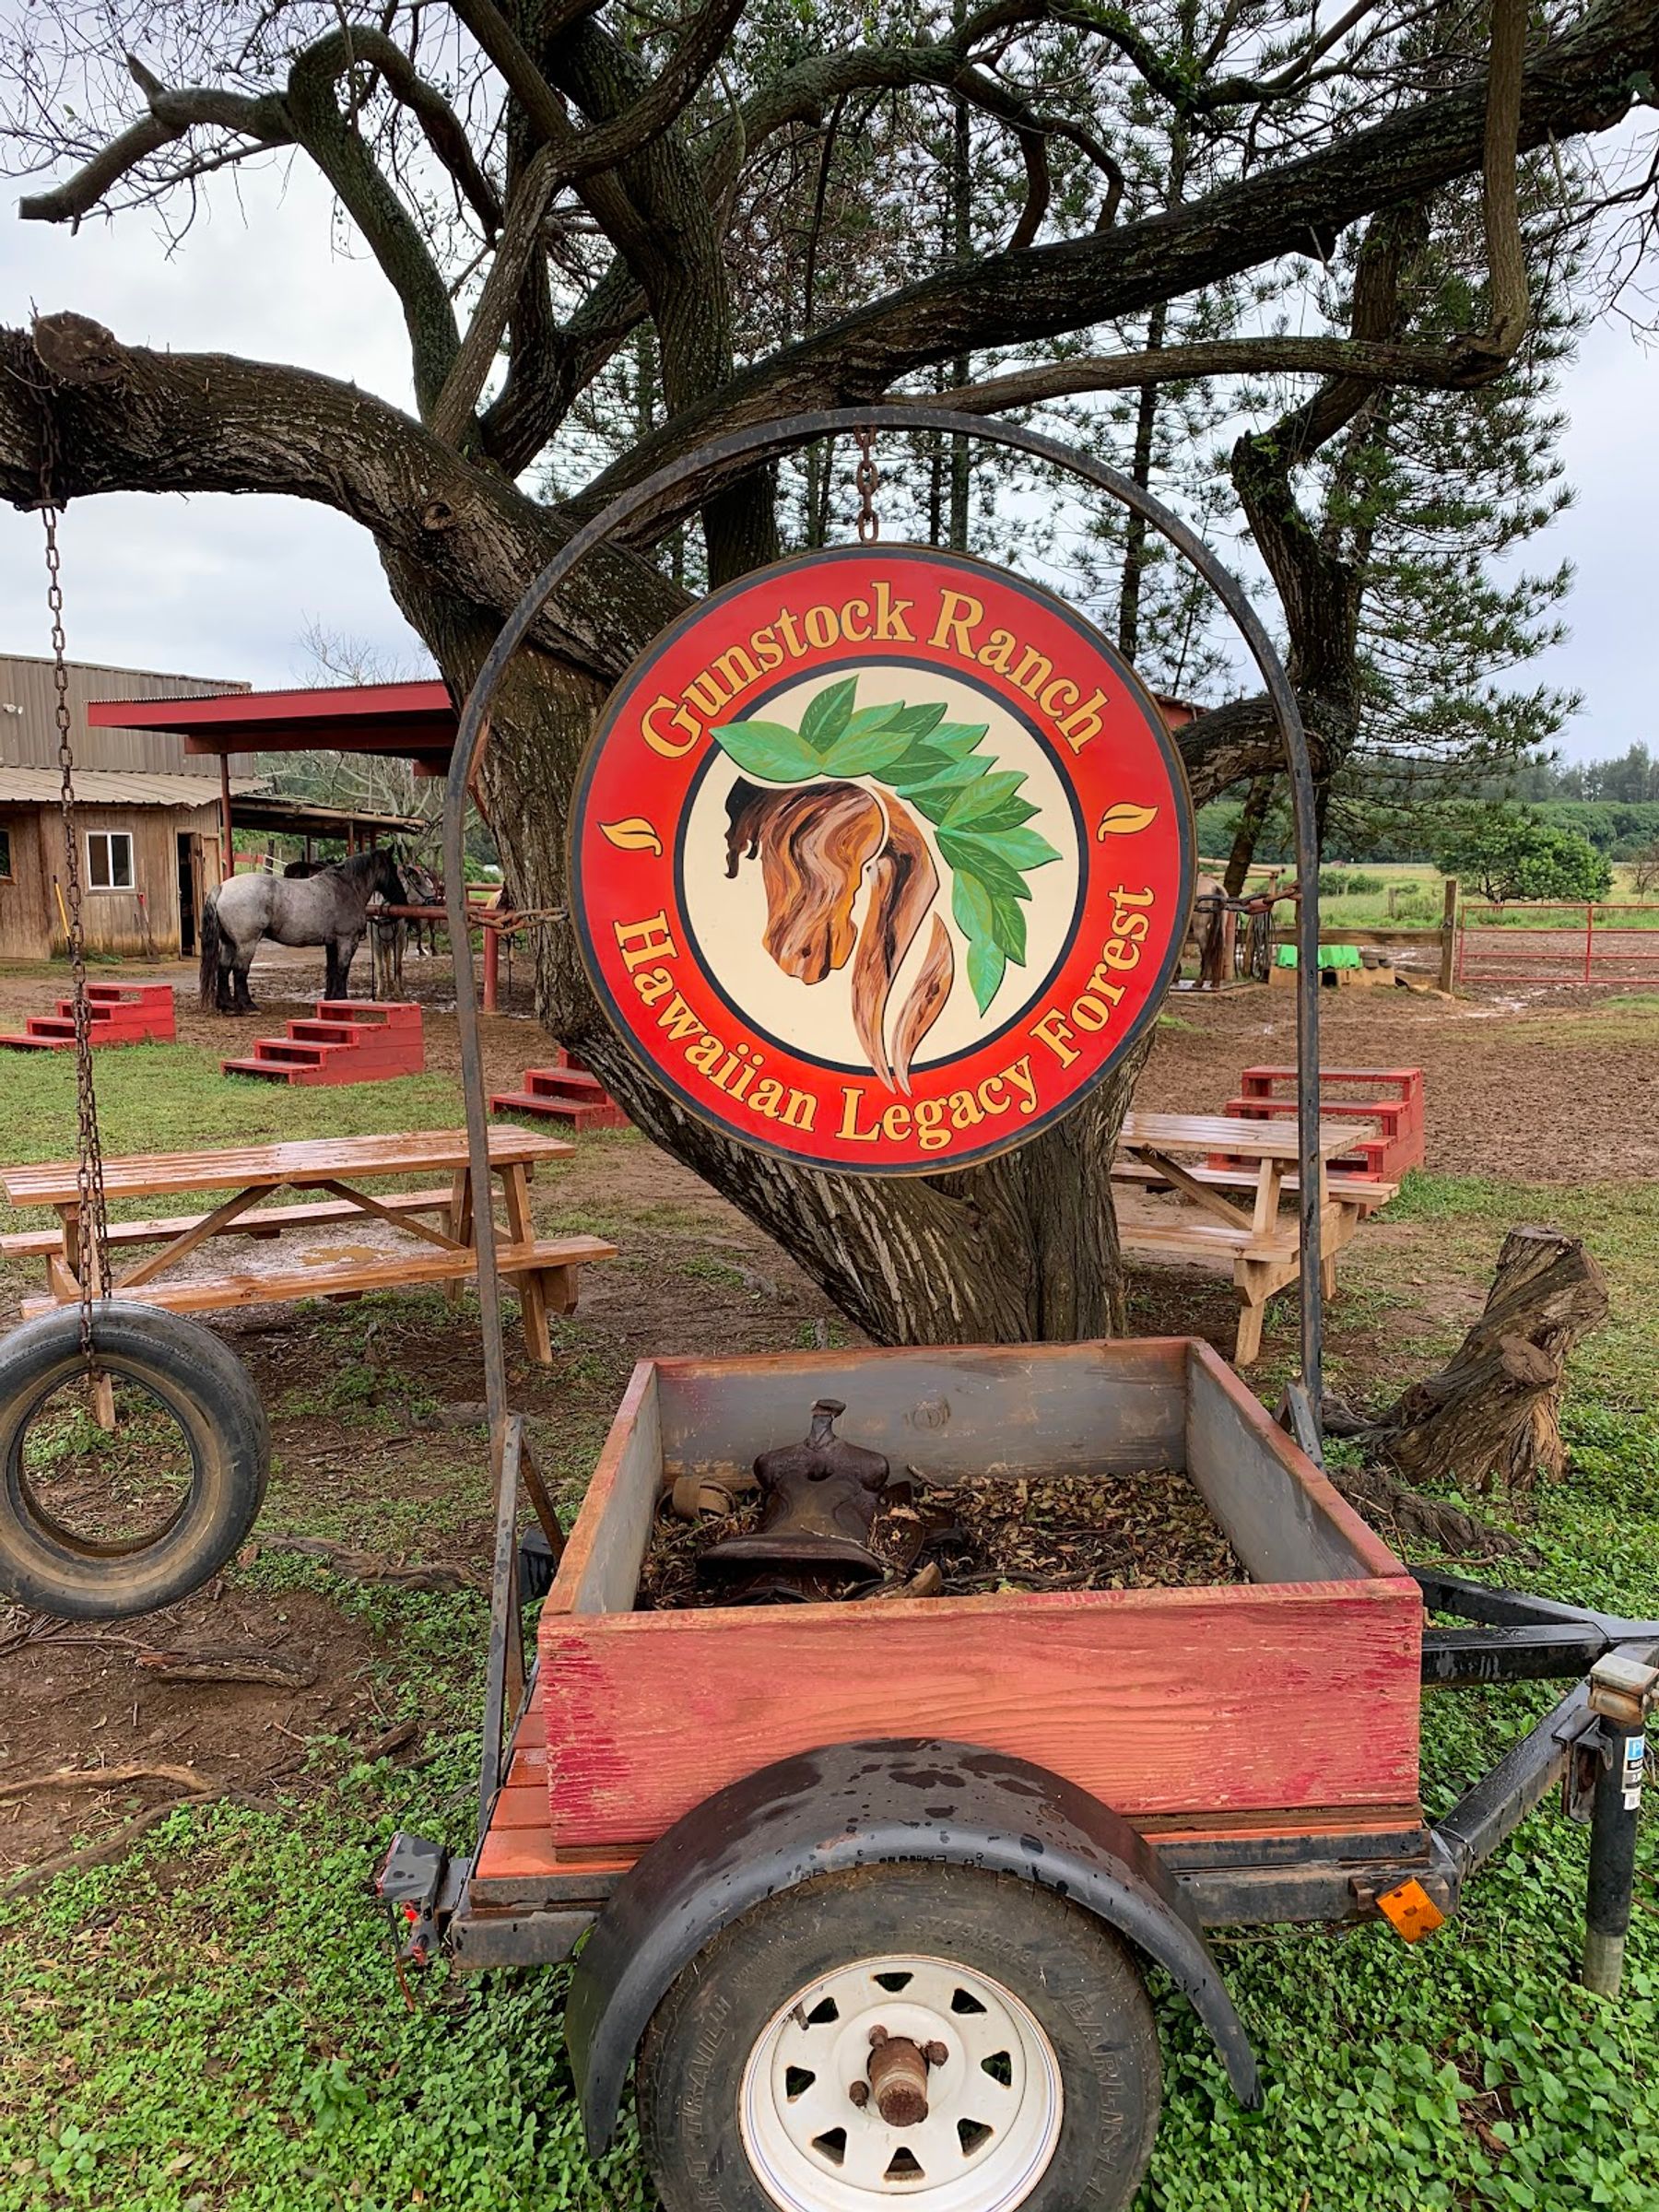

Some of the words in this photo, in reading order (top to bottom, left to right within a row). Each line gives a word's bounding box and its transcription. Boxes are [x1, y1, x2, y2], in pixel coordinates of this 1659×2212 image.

[640, 581, 915, 759] Gunstock
[926, 587, 1109, 756] Ranch
[612, 909, 818, 1132] Hawaiian
[836, 1053, 1039, 1150] Legacy
[1029, 884, 1156, 1070] Forest
